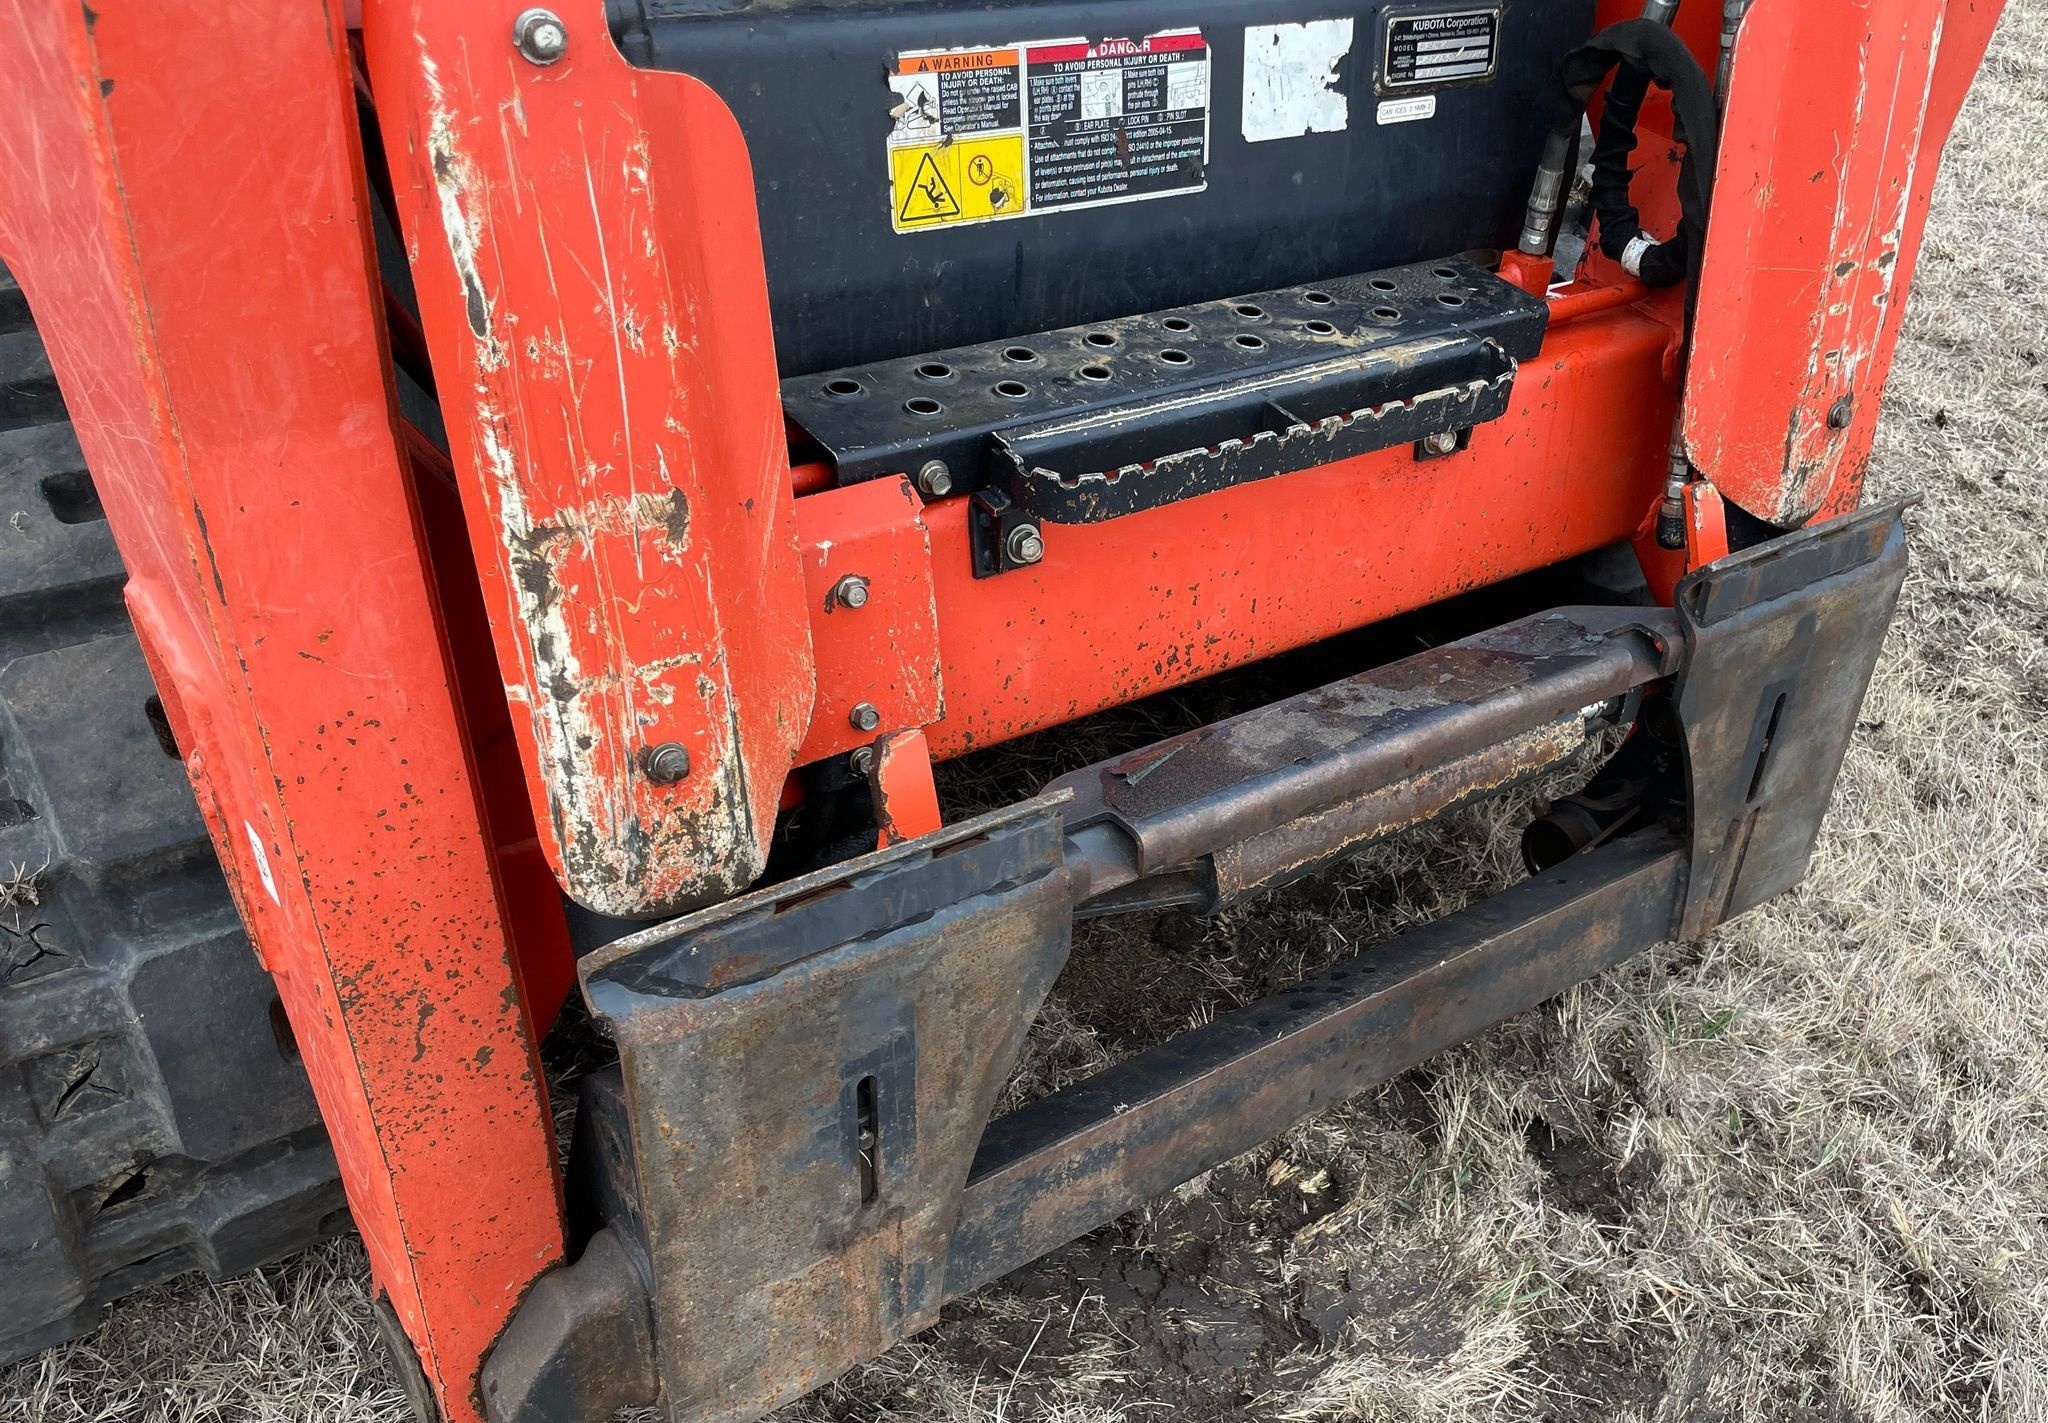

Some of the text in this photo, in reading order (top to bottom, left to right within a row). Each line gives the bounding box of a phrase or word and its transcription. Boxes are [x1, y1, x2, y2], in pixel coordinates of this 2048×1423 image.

[1413, 17, 1488, 31] KUBOTA Corporation
[932, 55, 993, 70] WARNING
[1054, 64, 1063, 72] TO
[1065, 62, 1085, 72] AVOID
[1088, 56, 1122, 70] PERSONAL
[1124, 55, 1146, 66] INJURY
[1149, 54, 1158, 64] OR
[952, 71, 974, 80] AVOID
[976, 68, 1012, 78] PERSONAL
[1139, 70, 1147, 78] sure
[1148, 68, 1157, 77] both
[1157, 68, 1165, 76] lock
[941, 80, 966, 89] INJURY
[980, 77, 1004, 86] DEATH:
[1065, 76, 1077, 84] levers
[1006, 83, 1018, 91] CAB
[1059, 84, 1073, 93] contact
[1128, 81, 1136, 91] pins
[1128, 89, 1159, 100] protrude through
[1042, 96, 1054, 105] plates
[1141, 100, 1150, 108] slots
[984, 103, 1001, 111] Manual
[1039, 105, 1052, 113] points
[1052, 104, 1060, 112] and
[943, 116, 966, 124] complete
[1042, 114, 1050, 123] way
[1084, 121, 1094, 130] EAR
[1095, 119, 1109, 128] PLATE
[1128, 117, 1140, 125] LOCK
[1141, 115, 1149, 123] PIN
[1166, 112, 1174, 121] PIN
[1175, 110, 1187, 120] SLOT
[1034, 140, 1056, 150] Attachm
[1074, 137, 1090, 146] comply
[1090, 135, 1100, 143] with
[1101, 134, 1109, 142] ISO
[1133, 130, 1147, 138] edition
[1034, 155, 1044, 163] Use
[1044, 154, 1049, 162] of
[1050, 152, 1077, 162] attachments
[1078, 150, 1086, 158] that
[1087, 149, 1093, 157] do
[1101, 146, 1116, 156] comply
[1136, 142, 1149, 151] 24410
[1163, 139, 1181, 148] improper
[1182, 136, 1203, 146] positioning
[1035, 168, 1039, 176] of
[1040, 167, 1057, 176] lever(s)
[1064, 162, 1094, 173] non-protrusion
[1096, 161, 1100, 169] of
[1101, 160, 1113, 169] pin(s)
[1141, 153, 1165, 163] detachment
[1166, 151, 1170, 160] of
[1178, 148, 1201, 158] attachment
[1041, 179, 1068, 189] deformation,
[1069, 176, 1086, 186] causing
[1096, 173, 1100, 181] of
[1102, 170, 1129, 182] performance,
[1130, 168, 1148, 178] personal
[1149, 166, 1160, 175] injury
[1166, 163, 1179, 172] death.
[1044, 191, 1070, 201] information,
[1070, 188, 1086, 198] contact
[1087, 188, 1097, 197] your
[1098, 185, 1112, 193] Kubota
[1114, 183, 1128, 192] Dealer.
